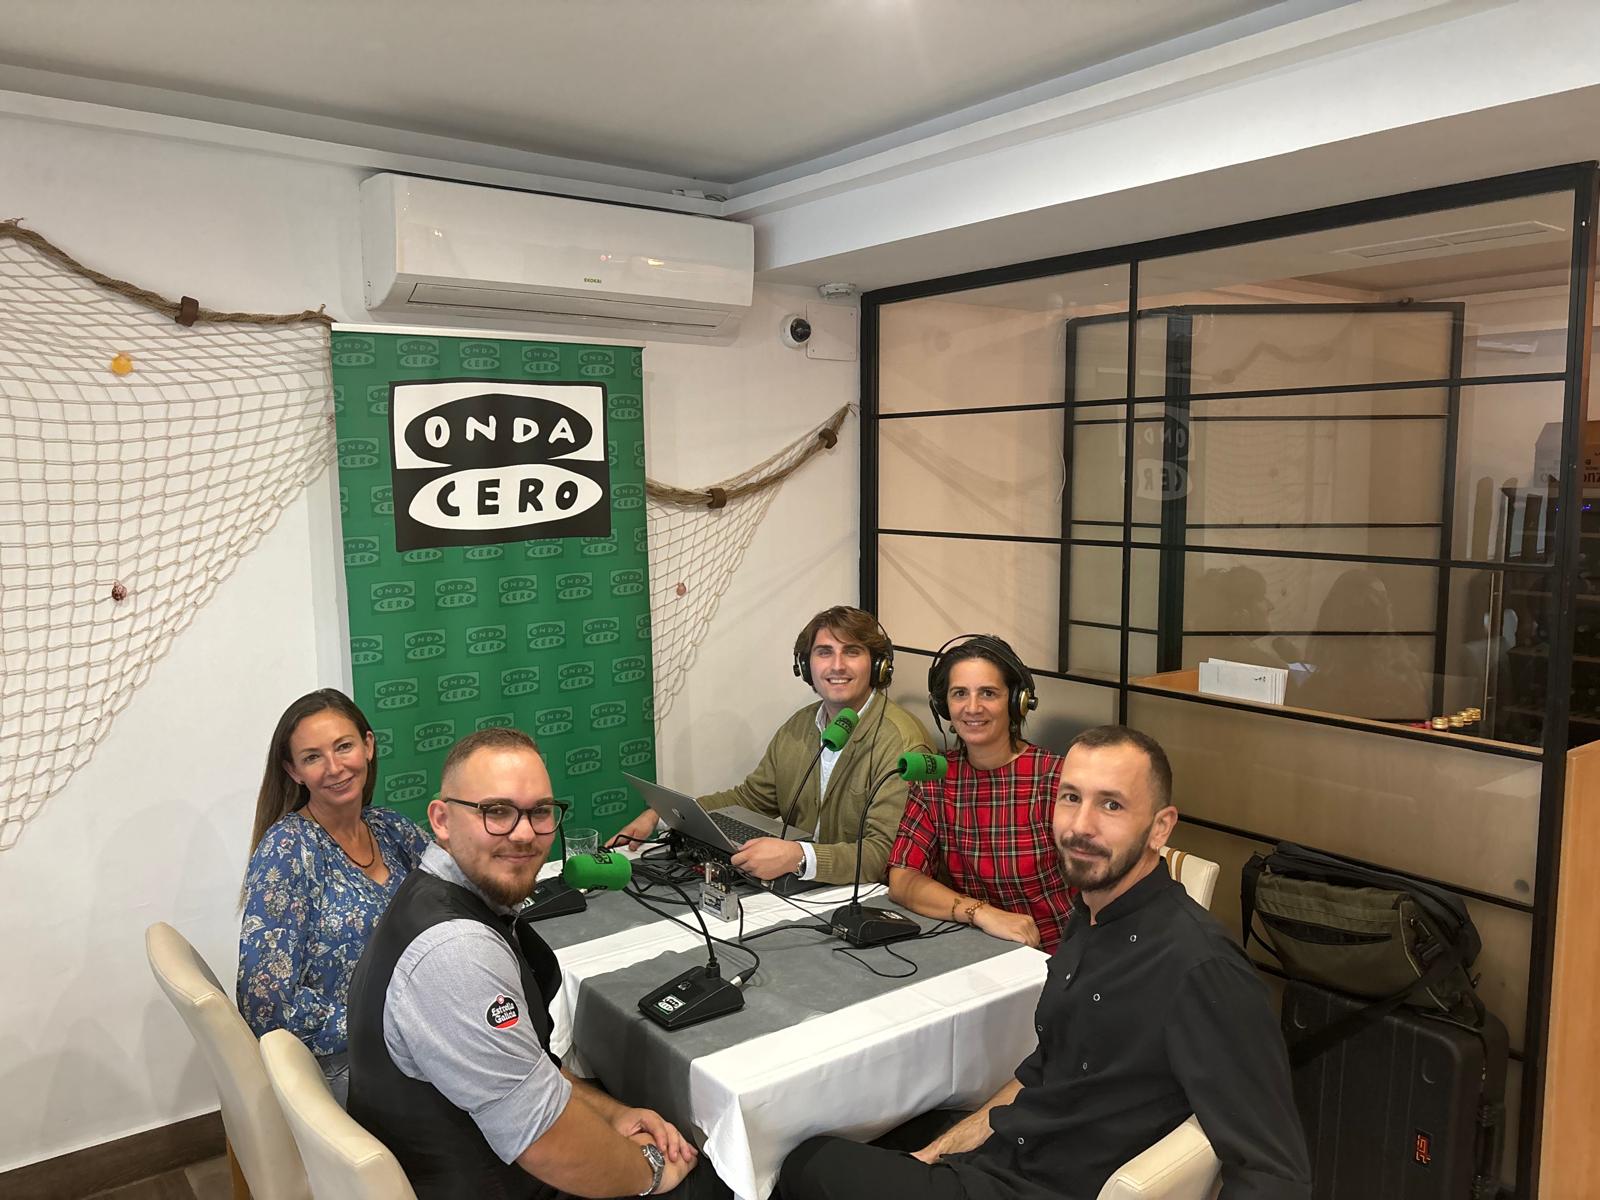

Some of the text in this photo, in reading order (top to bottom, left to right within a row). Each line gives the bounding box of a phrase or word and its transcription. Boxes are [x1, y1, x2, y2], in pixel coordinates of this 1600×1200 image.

[424, 415, 575, 448] ONDA
[339, 443, 373, 451] ONDA
[436, 478, 579, 517] CERO
[440, 584, 470, 592] ONDA
[503, 580, 532, 589] ONDA
[376, 588, 409, 596] ONDA
[471, 631, 501, 640] ONDA
[532, 627, 561, 635] ONDA
[409, 635, 440, 645] ONDA
[505, 672, 534, 681] ONDA
[443, 679, 474, 688] ONDA
[380, 684, 412, 694] ONDA
[540, 713, 568, 721] ONDA
[419, 726, 449, 736] ONDA
[390, 776, 421, 787] ONDA
[495, 1011, 517, 1024] Galicia
